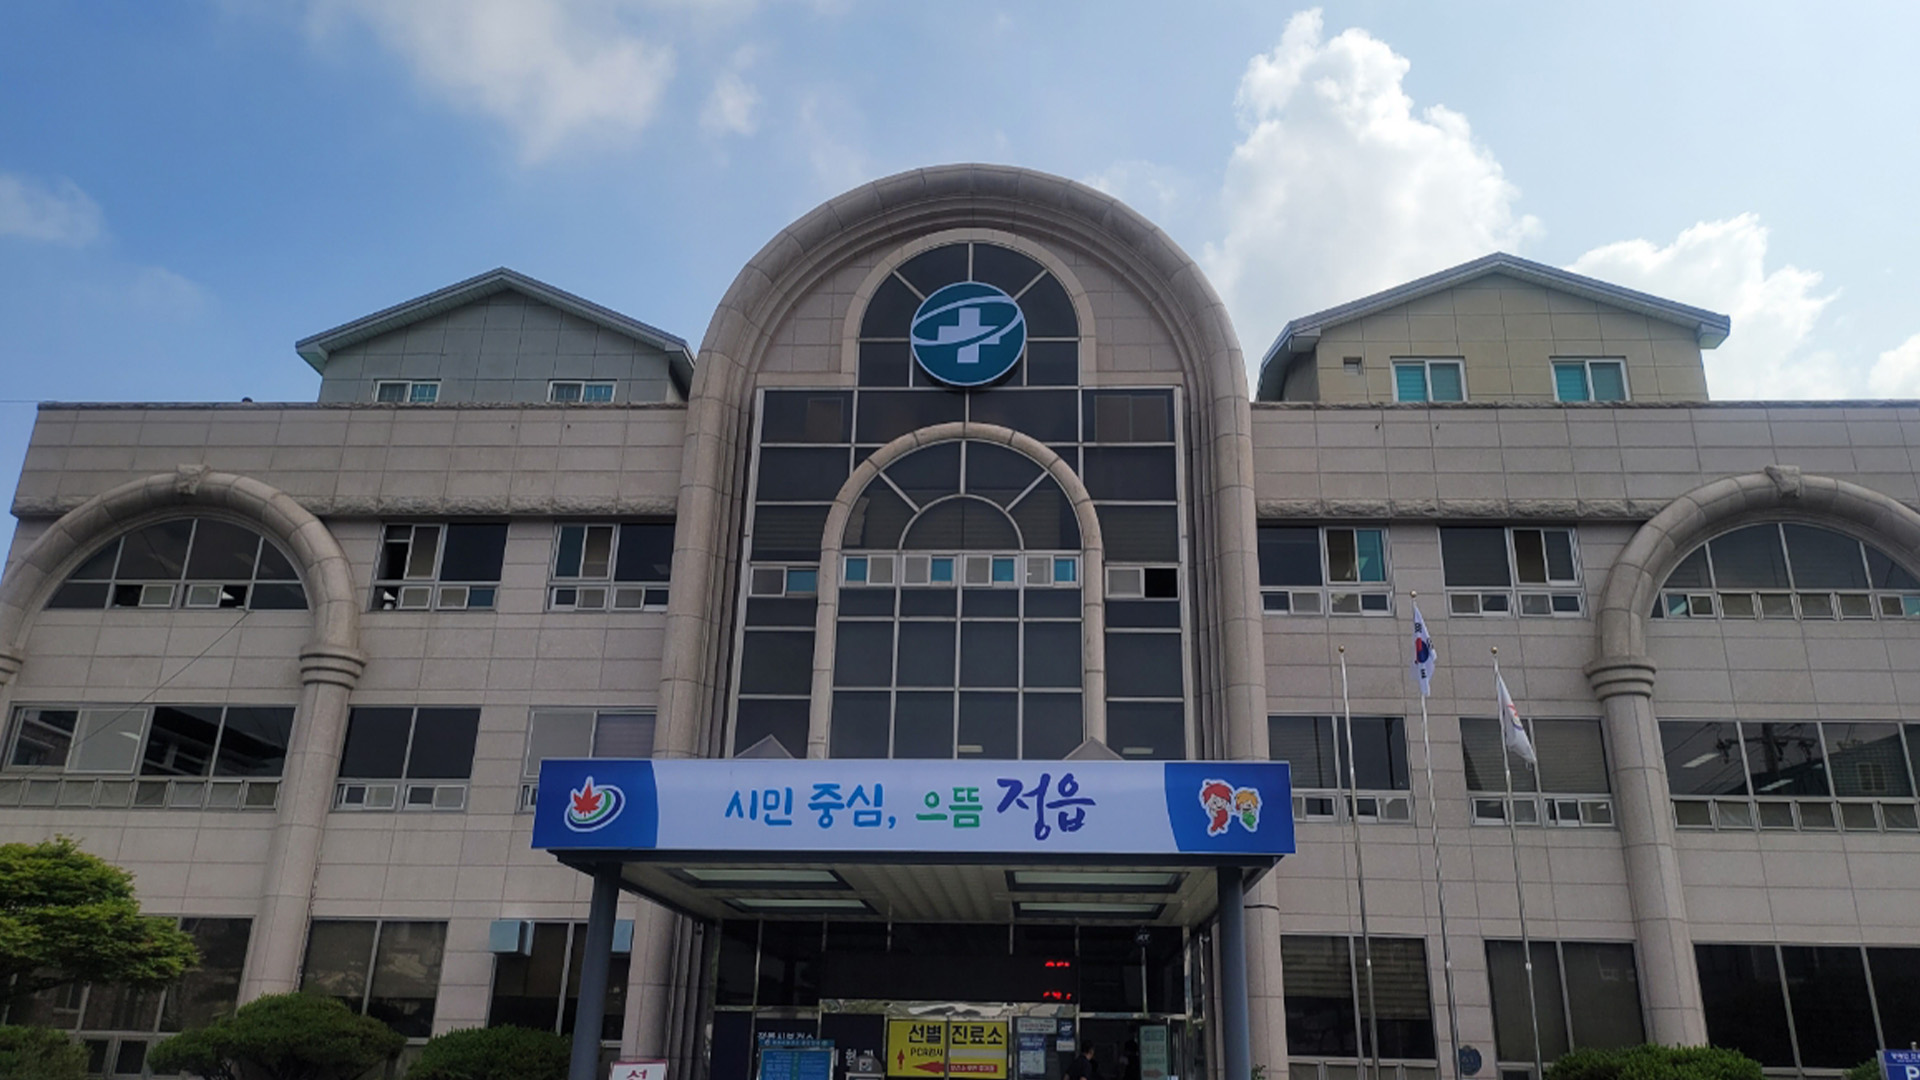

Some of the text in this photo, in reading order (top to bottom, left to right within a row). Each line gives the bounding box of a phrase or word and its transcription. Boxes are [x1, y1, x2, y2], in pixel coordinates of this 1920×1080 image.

[725, 773, 1096, 840] 시민 중심, 으뜸 정읍
[908, 1024, 941, 1044] 선별
[952, 1025, 1002, 1045] 진료소
[910, 1047, 943, 1057] PCR검사
